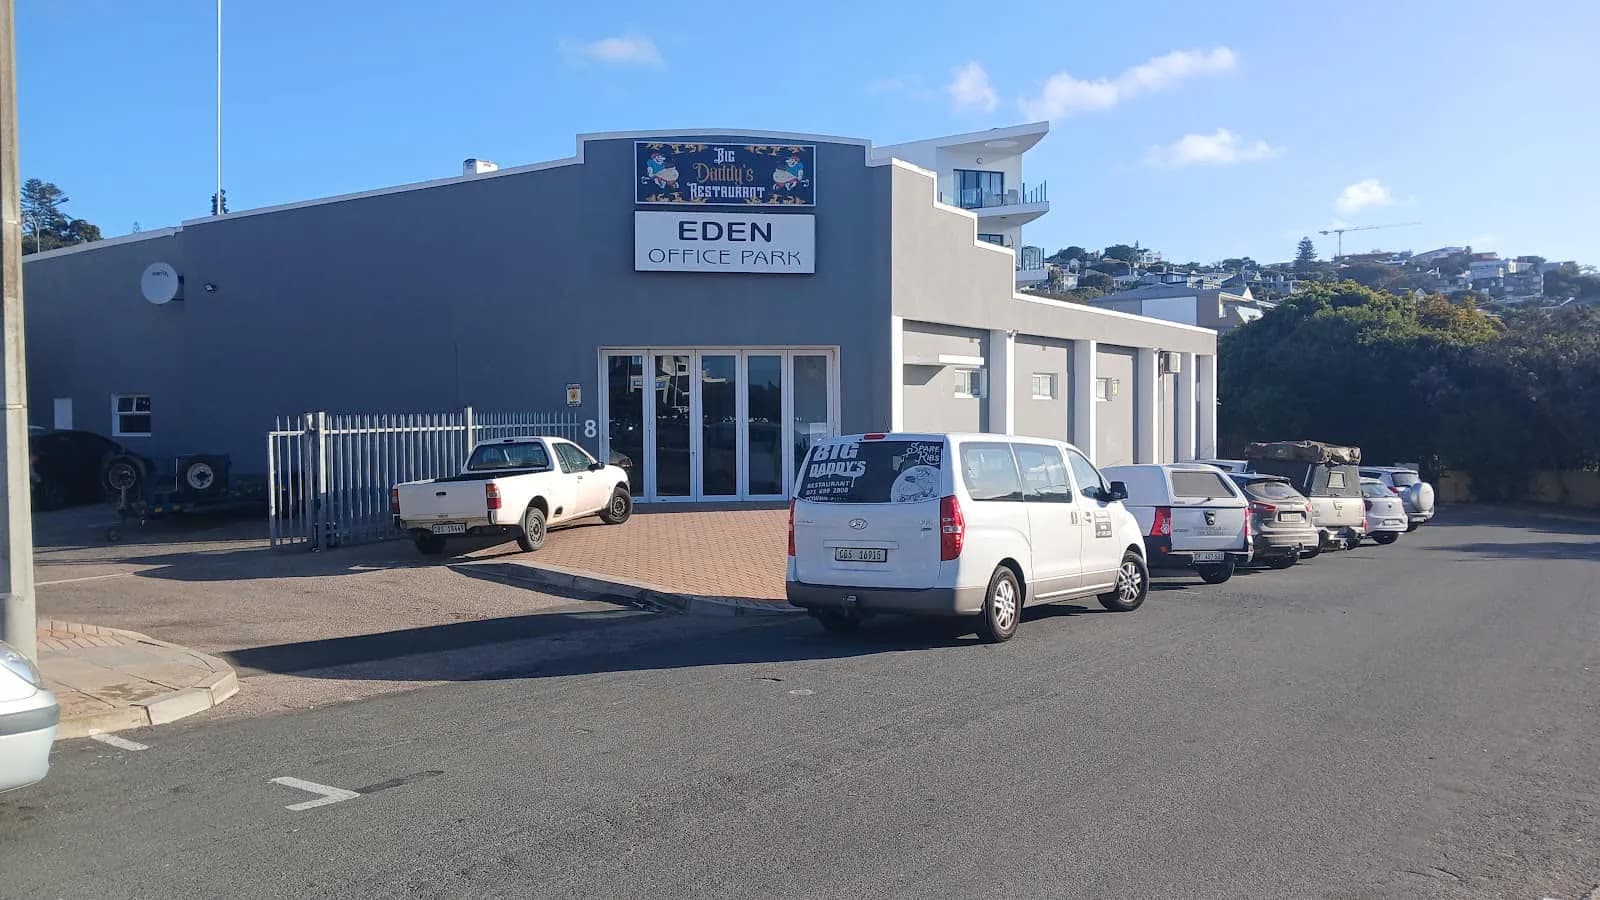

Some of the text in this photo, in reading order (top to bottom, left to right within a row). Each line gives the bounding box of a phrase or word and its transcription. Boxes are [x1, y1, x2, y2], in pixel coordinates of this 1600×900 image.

[692, 162, 754, 185] Daddy's
[678, 220, 772, 243] EDEN
[648, 248, 731, 265] OFFICE
[741, 250, 801, 266] PARK
[584, 419, 597, 438] 8
[812, 443, 860, 462] BIG
[809, 460, 867, 478] DADDY'S
[806, 480, 850, 489] RESTAURANT
